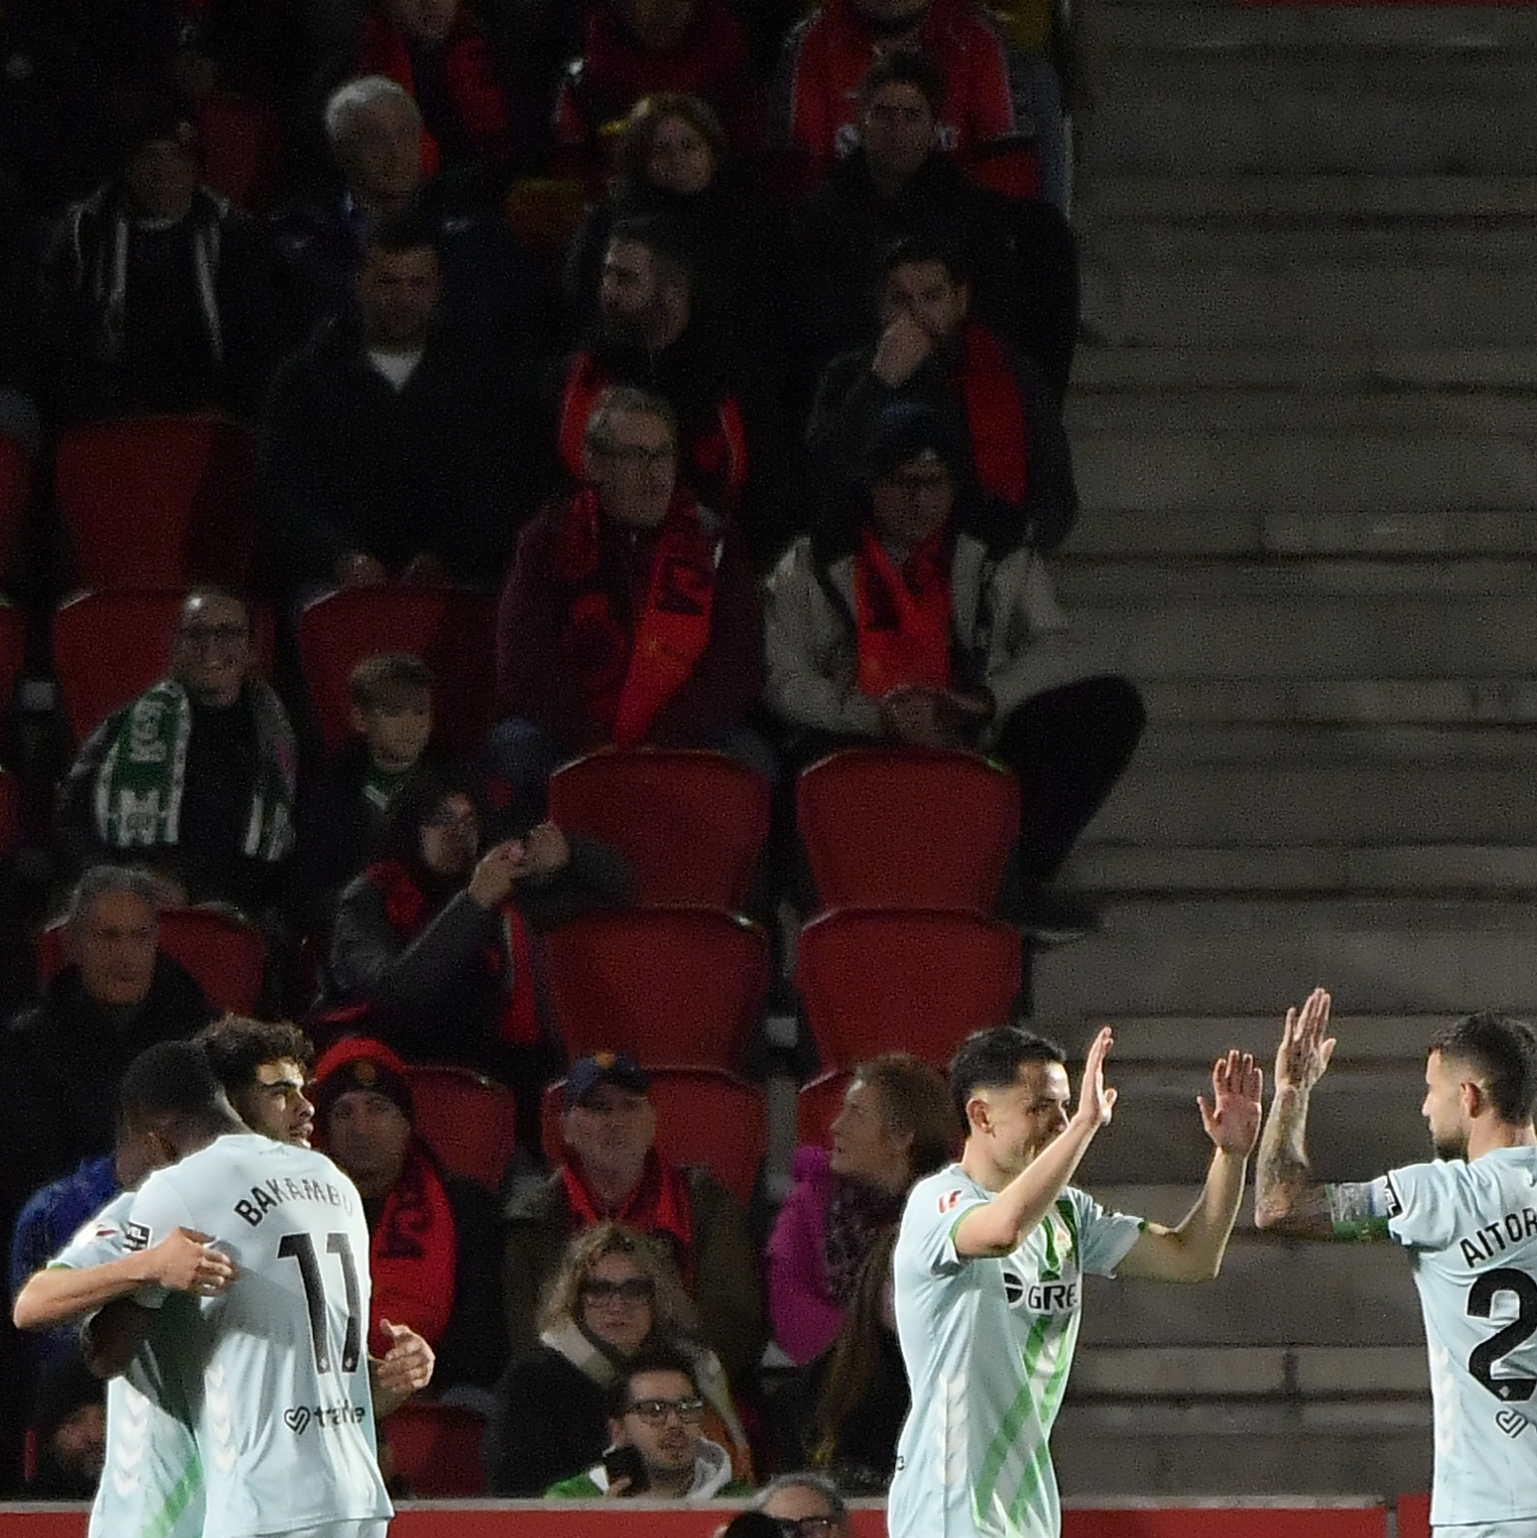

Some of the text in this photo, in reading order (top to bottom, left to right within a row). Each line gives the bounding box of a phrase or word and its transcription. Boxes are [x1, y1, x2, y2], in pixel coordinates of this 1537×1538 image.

[234, 1178, 354, 1228] BAKAMBU
[277, 1232, 361, 1374] 11
[1028, 1284, 1078, 1309] GRE
